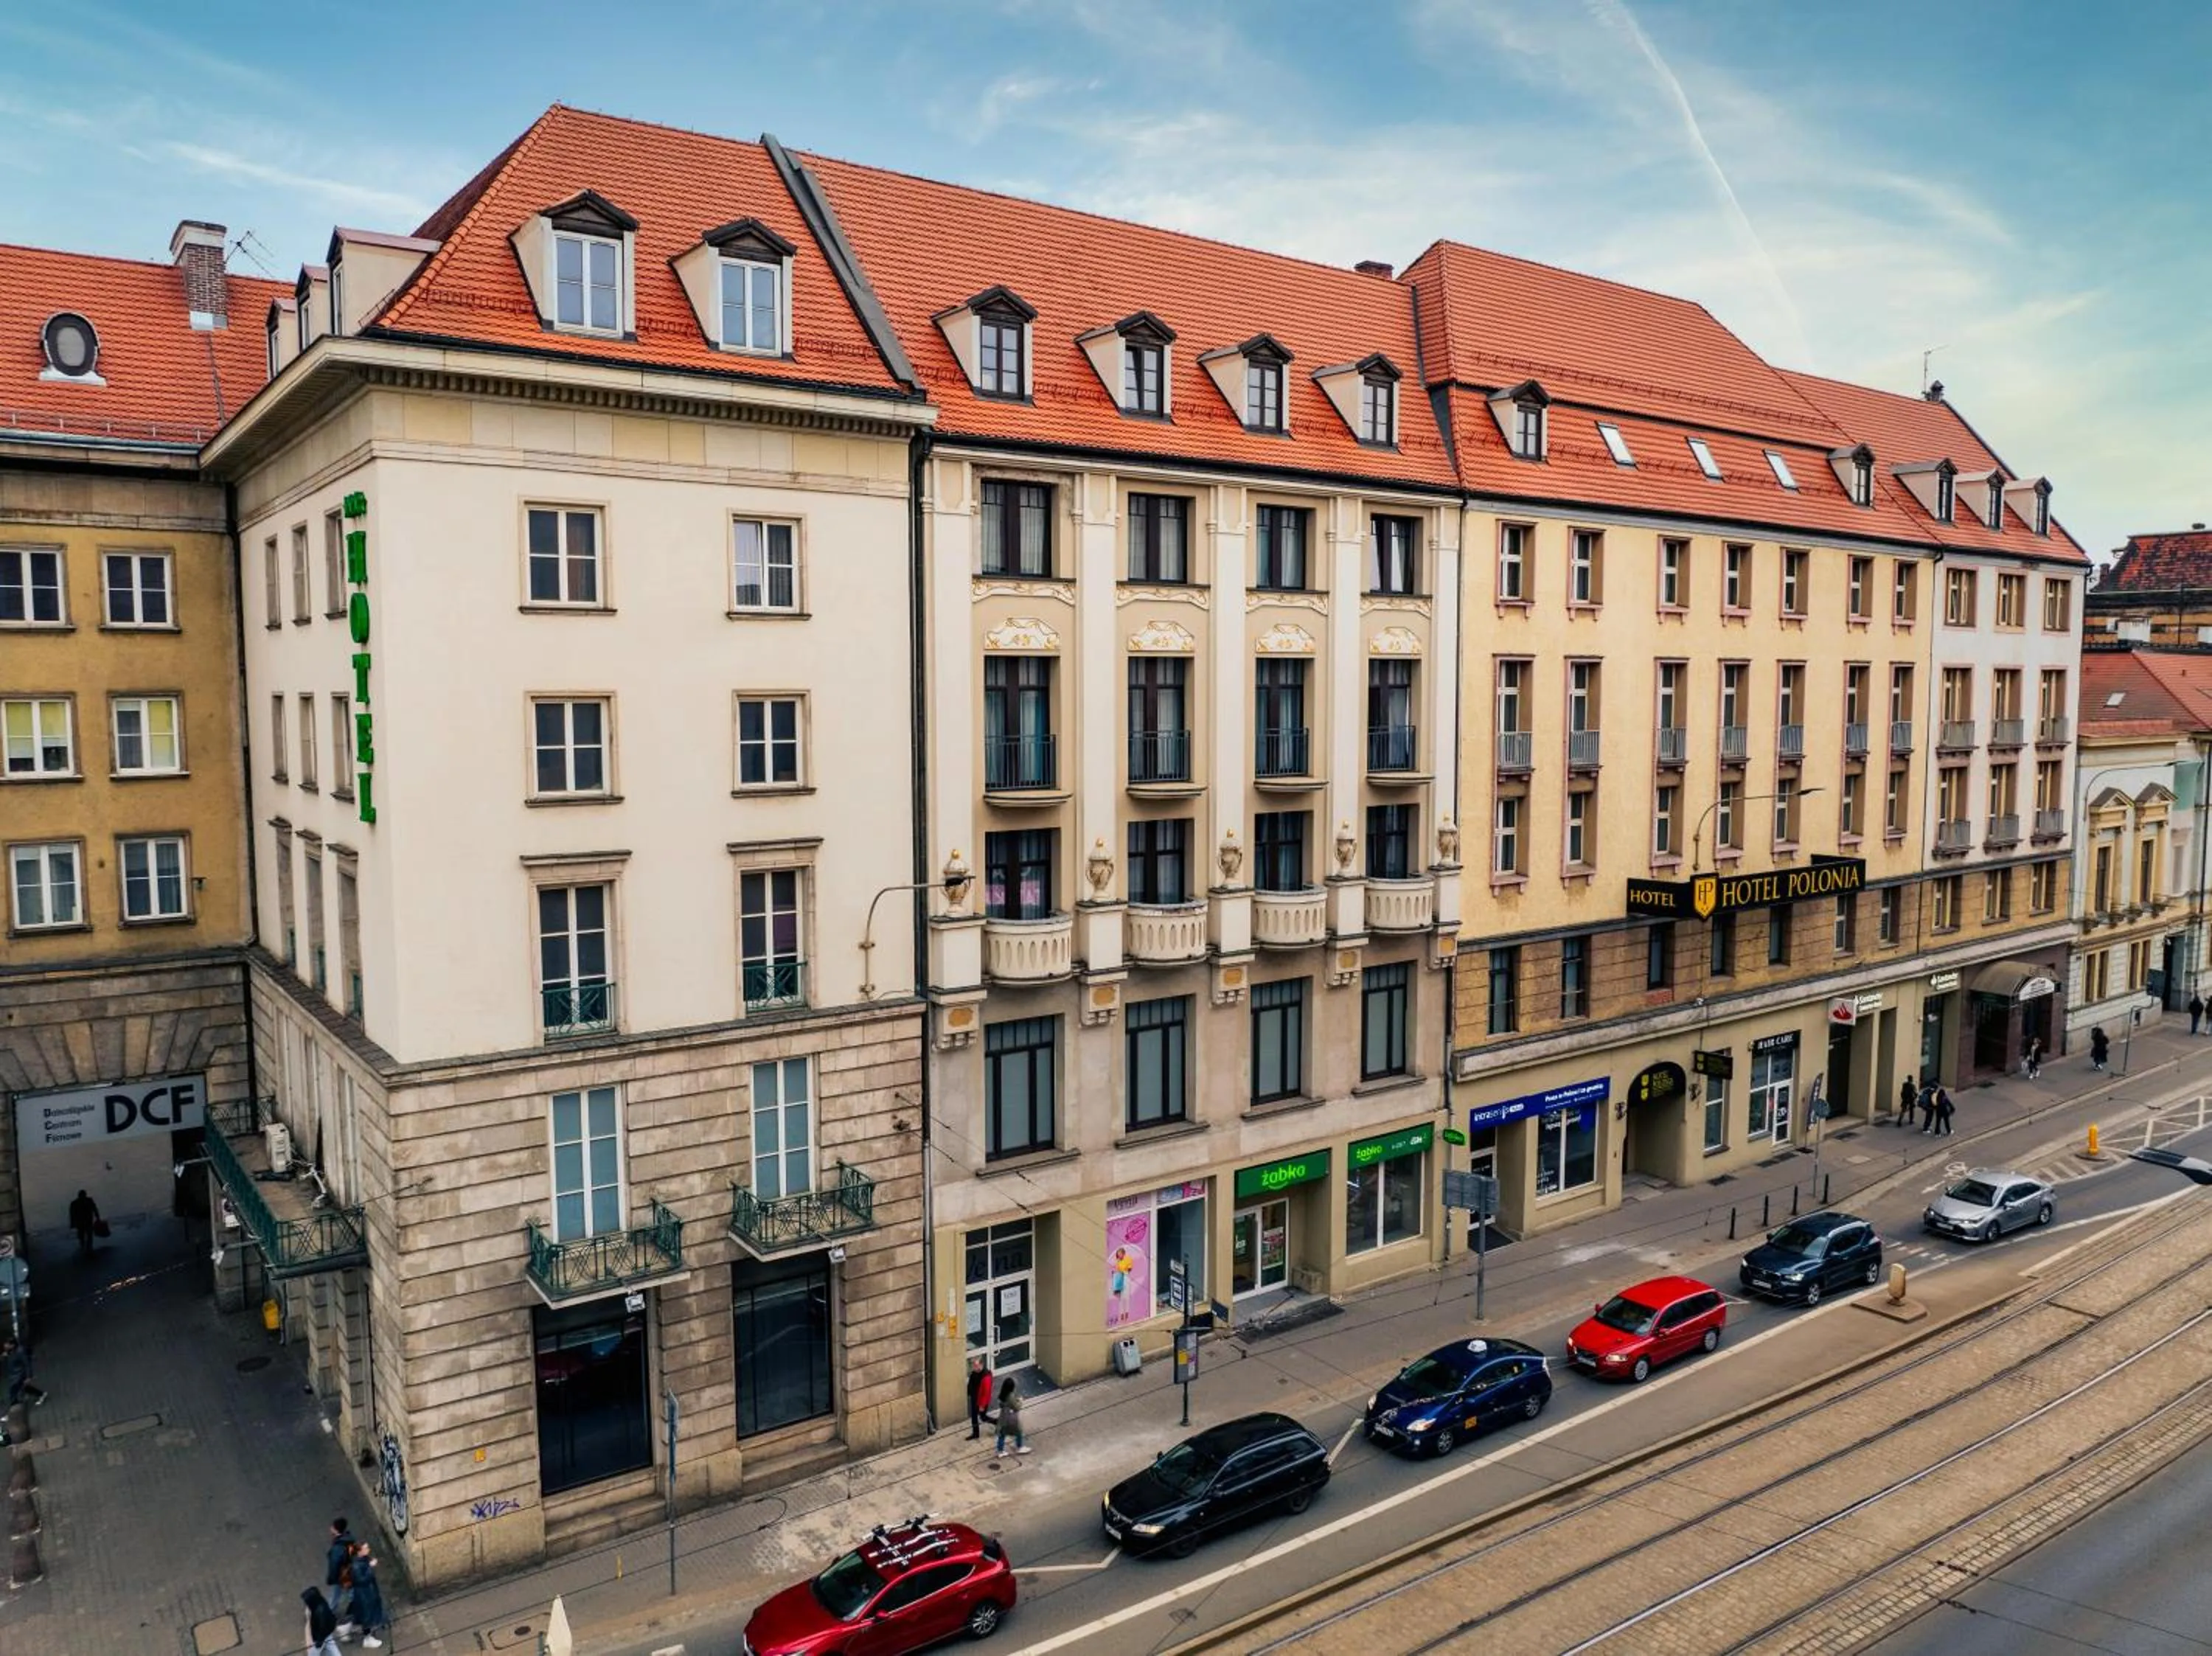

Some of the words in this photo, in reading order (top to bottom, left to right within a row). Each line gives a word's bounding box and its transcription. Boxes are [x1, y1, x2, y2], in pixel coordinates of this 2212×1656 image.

[1630, 889, 1676, 907] HOTEL
[1722, 877, 1781, 908] HOTEL
[1788, 866, 1859, 897] POLONIA
[105, 1084, 195, 1133] DCF
[1262, 1164, 1306, 1186] żabka
